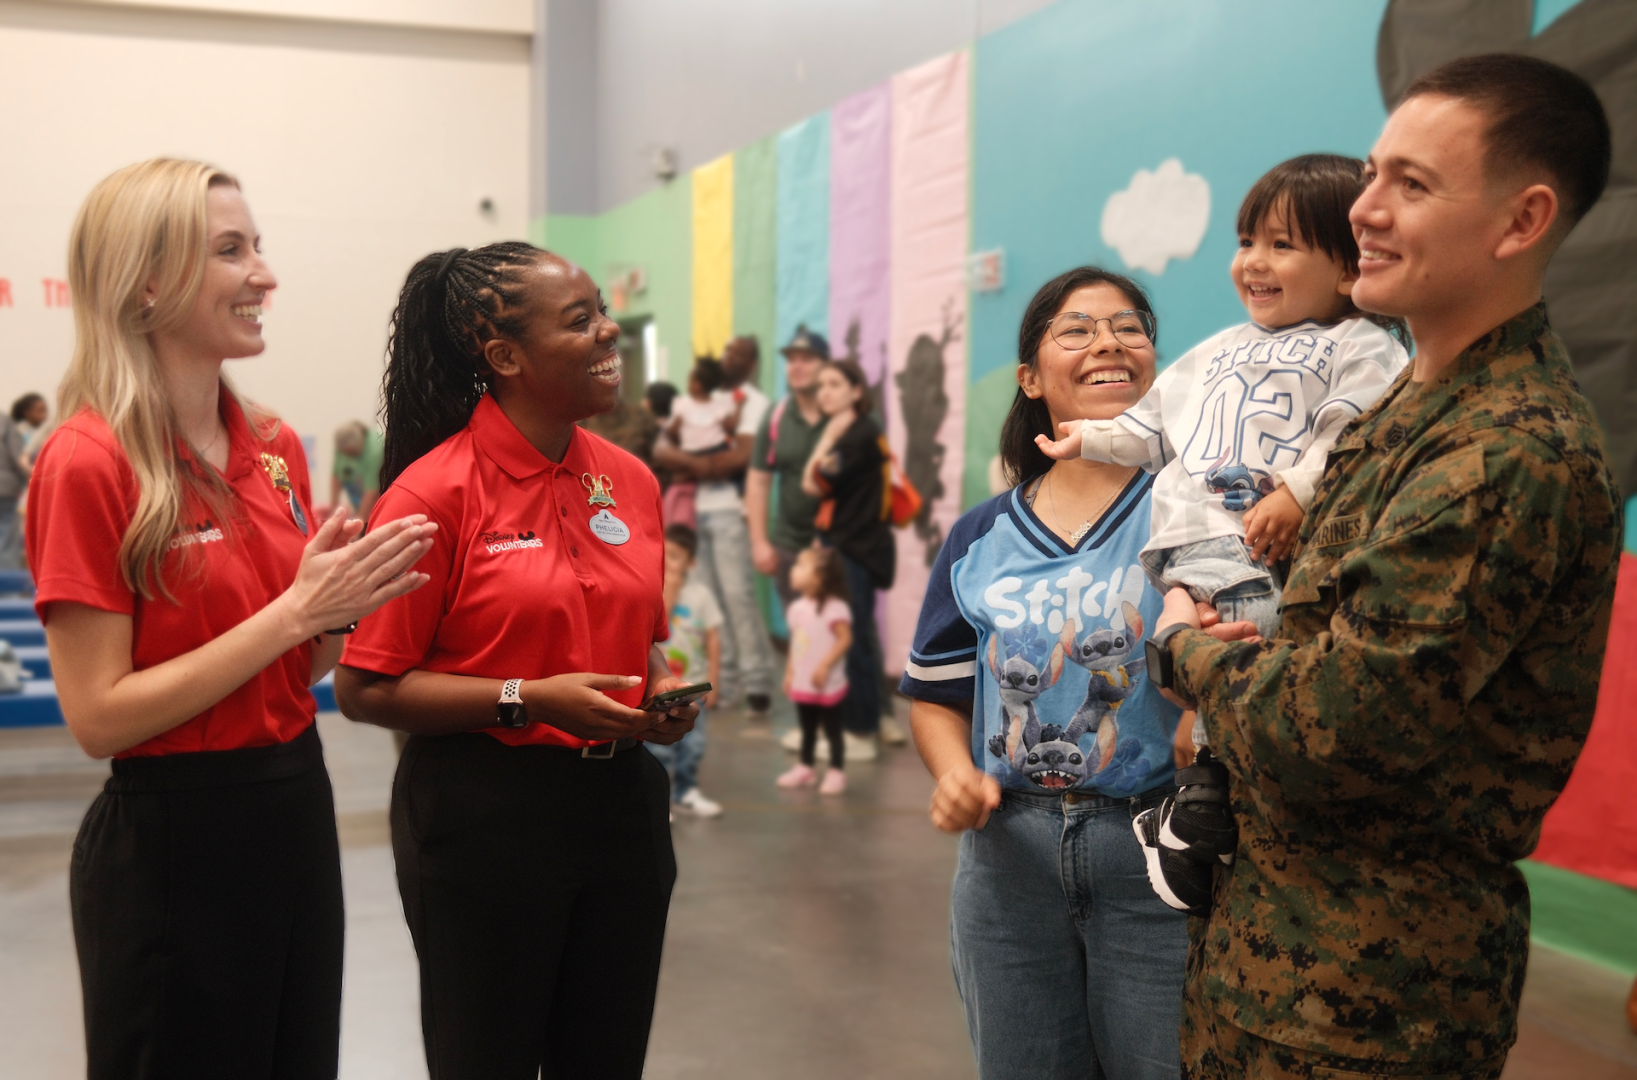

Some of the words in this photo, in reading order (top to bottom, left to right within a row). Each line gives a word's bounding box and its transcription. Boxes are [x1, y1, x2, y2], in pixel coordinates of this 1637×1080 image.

[1203, 334, 1338, 386] STITCH
[1181, 369, 1309, 477] 02
[479, 531, 515, 545] Disney
[595, 524, 624, 533] PHELICIA
[1312, 517, 1361, 547] ARINES
[486, 538, 543, 554] VOLUNTEARS
